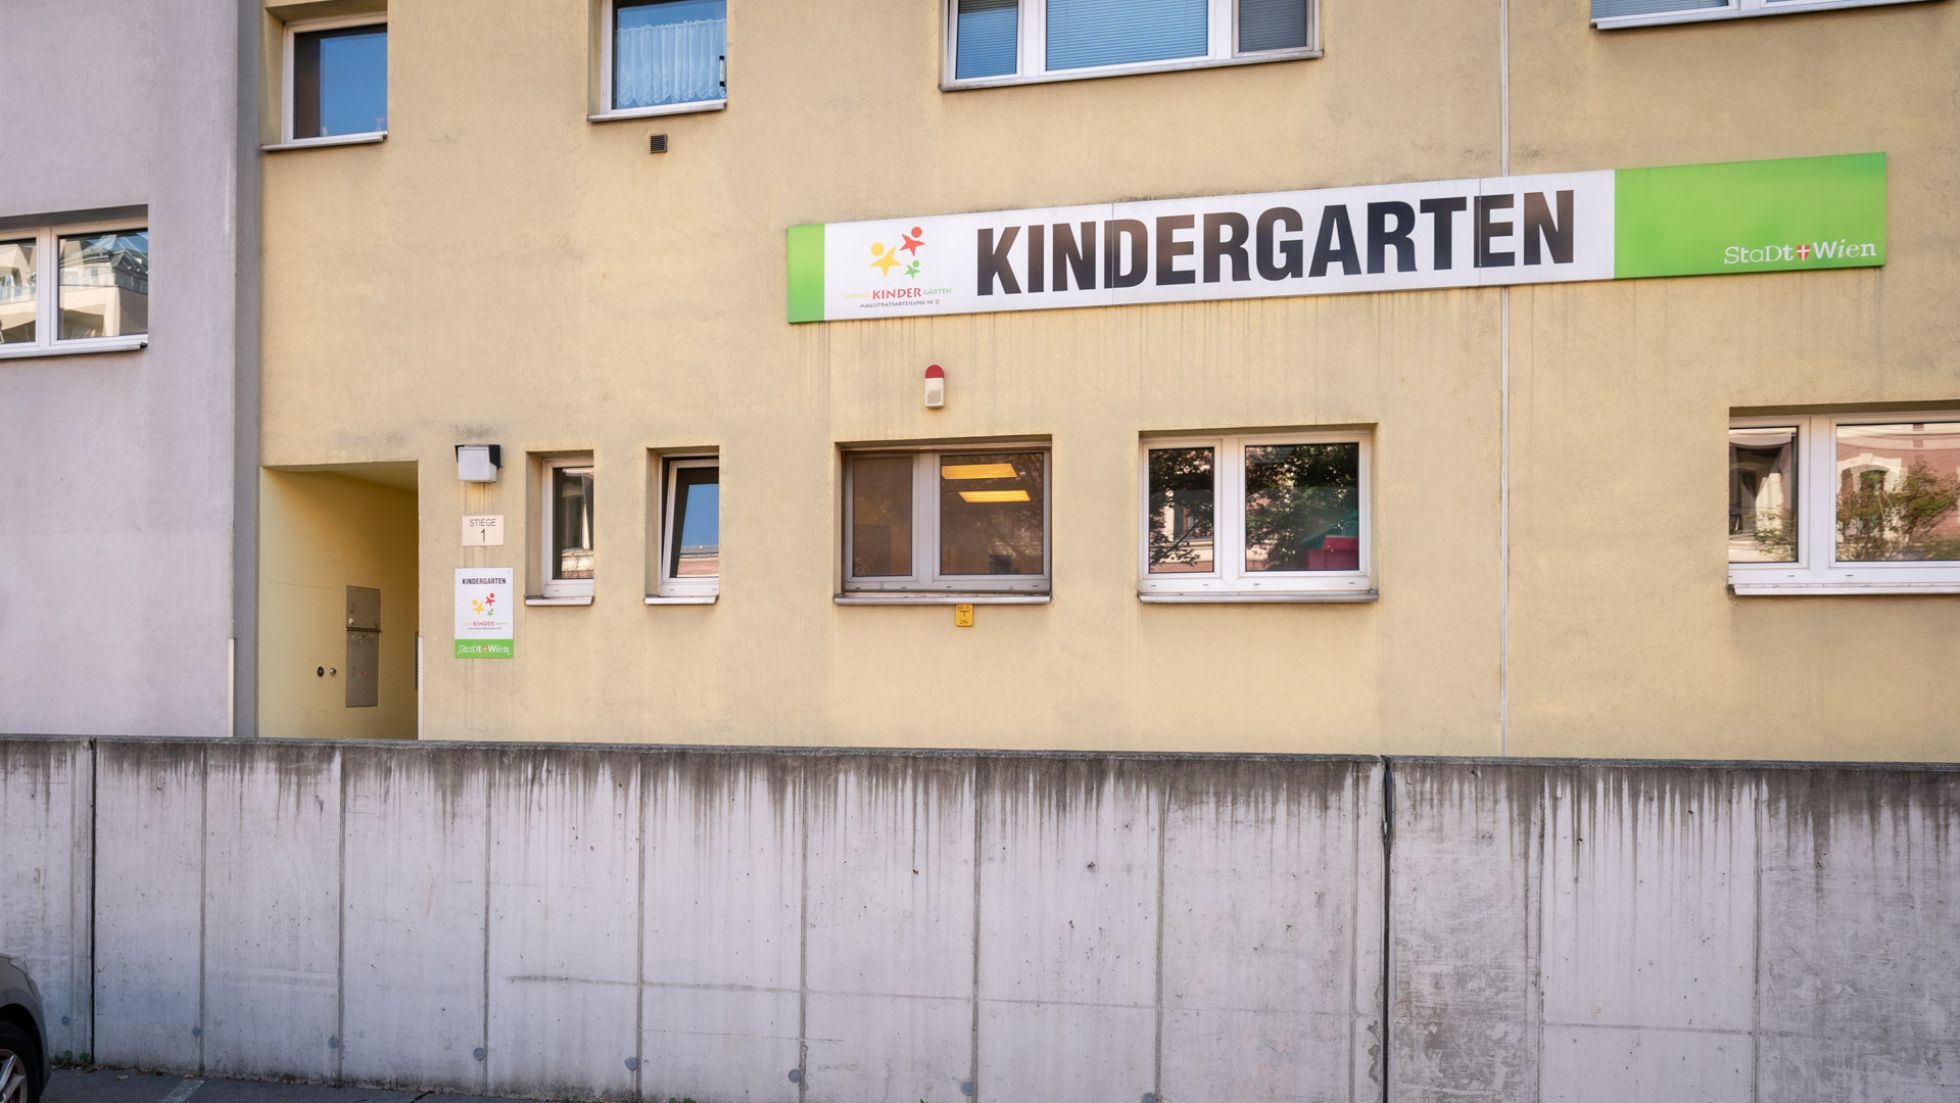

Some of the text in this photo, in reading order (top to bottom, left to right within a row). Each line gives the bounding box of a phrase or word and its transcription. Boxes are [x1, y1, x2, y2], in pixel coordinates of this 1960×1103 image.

[977, 189, 1574, 296] KINDERGARTEN
[1813, 238, 1877, 259] Wien
[872, 288, 922, 300] KINDER
[469, 518, 497, 527] STIEGE
[480, 528, 486, 543] 1
[462, 577, 507, 585] KINDERGARTEN
